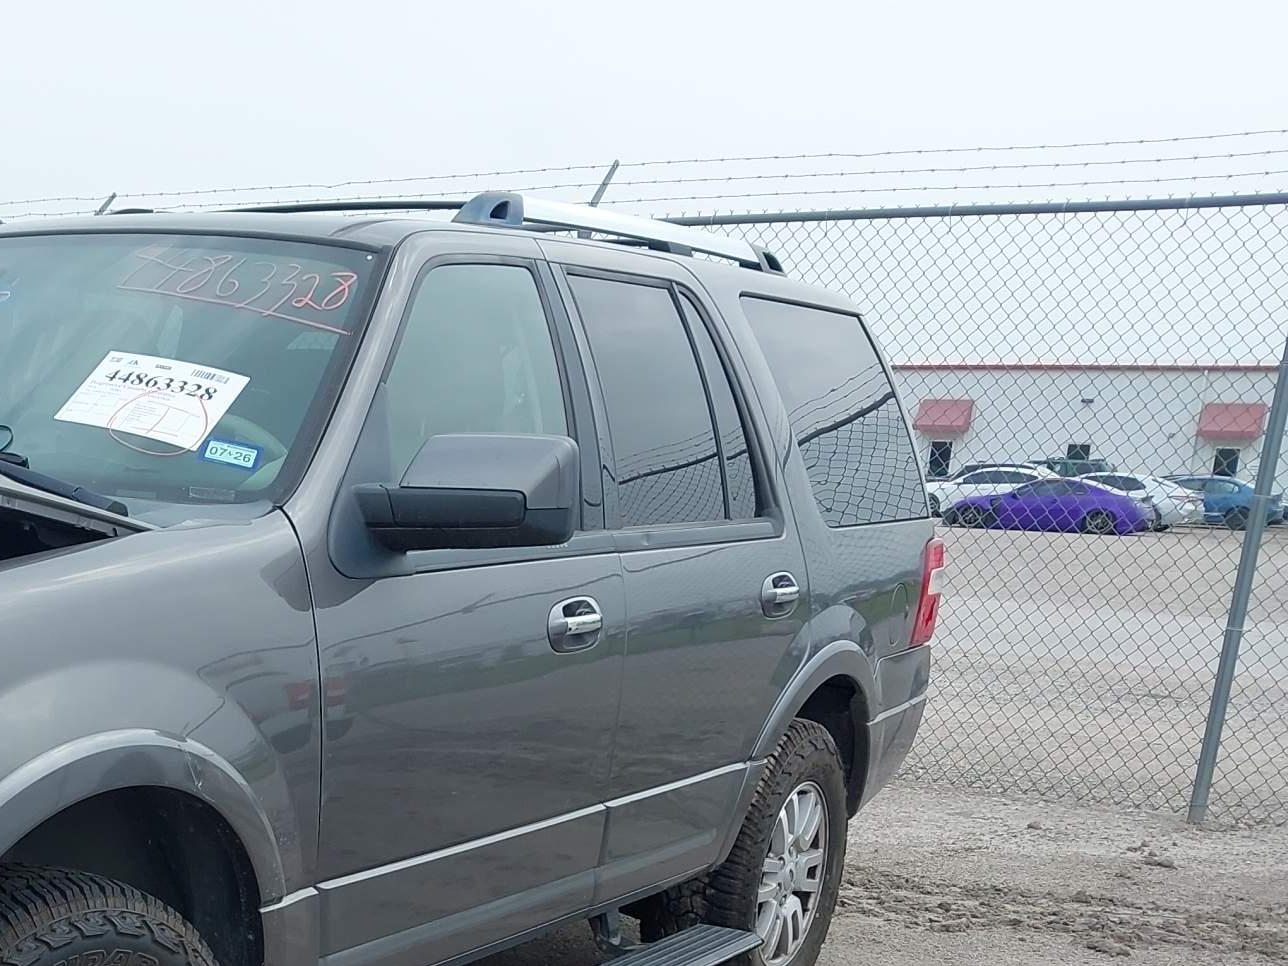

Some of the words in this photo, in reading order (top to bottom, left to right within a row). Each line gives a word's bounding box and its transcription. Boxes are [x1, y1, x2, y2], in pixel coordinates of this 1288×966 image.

[119, 247, 357, 317] 44863328
[105, 369, 217, 401] 44863328
[209, 446, 228, 457] 07
[233, 451, 252, 463] 26
